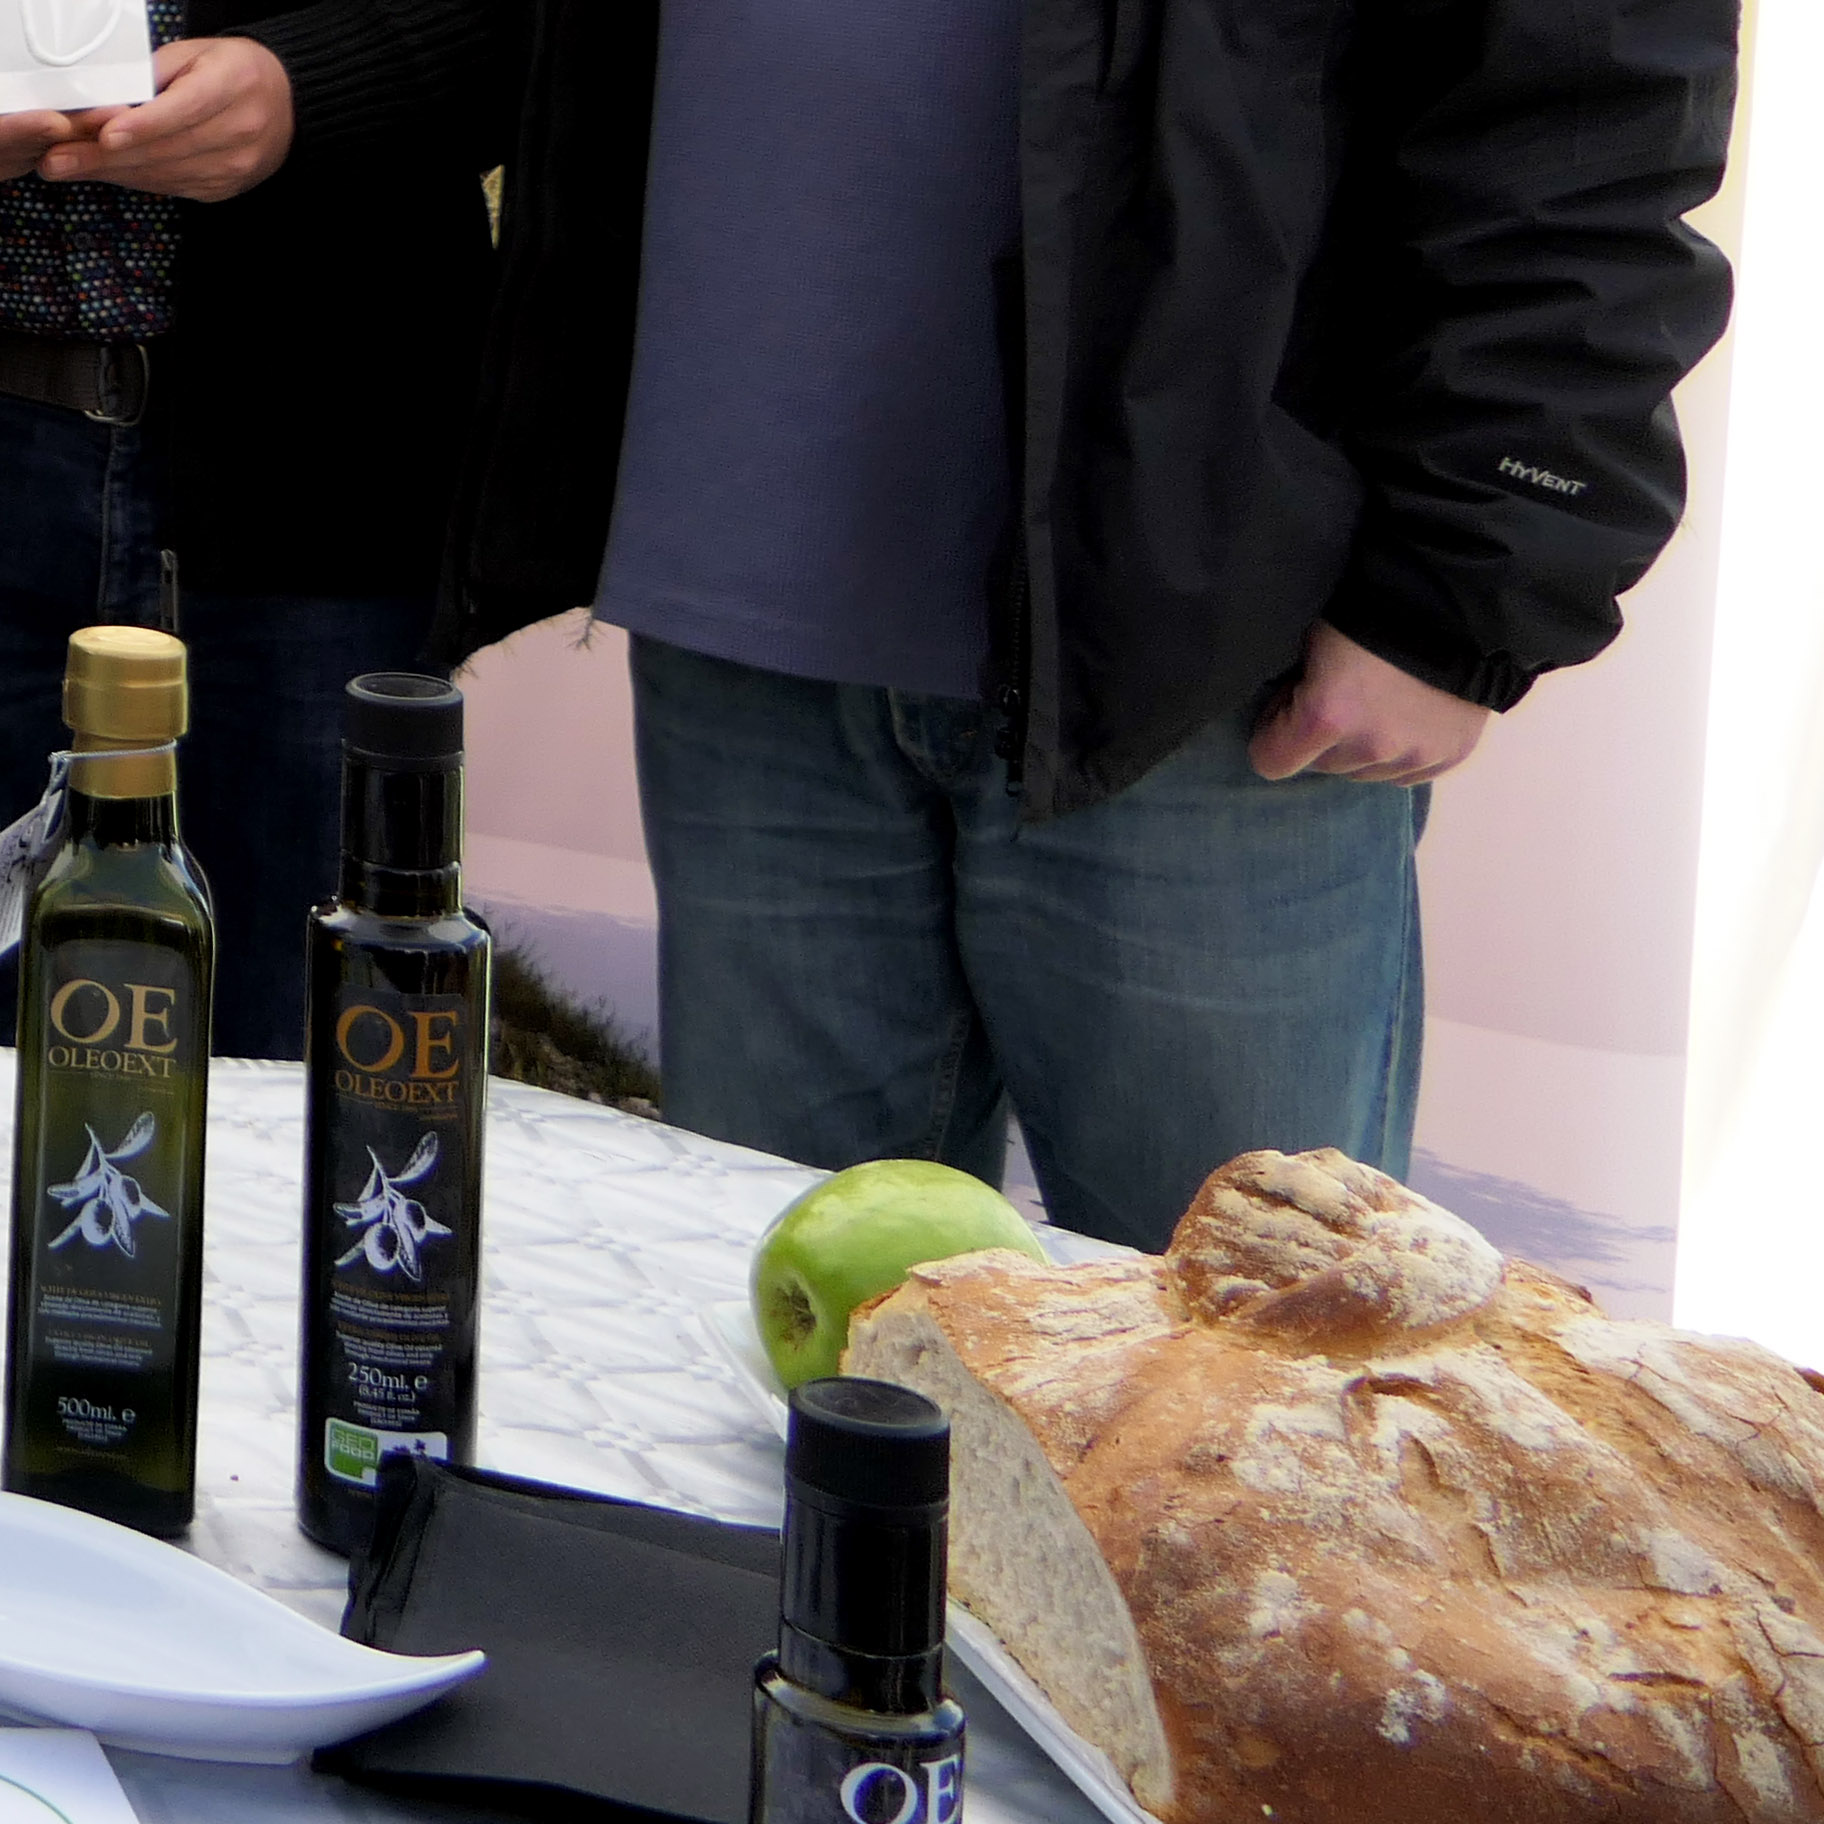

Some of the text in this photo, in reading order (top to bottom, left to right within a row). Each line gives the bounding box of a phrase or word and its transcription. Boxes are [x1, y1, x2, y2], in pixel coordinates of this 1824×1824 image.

[50, 979, 178, 1054] OE
[336, 1005, 460, 1079] OE
[48, 1045, 177, 1078] OLEOEXT
[335, 1070, 460, 1103] OLEOEXT
[840, 1754, 962, 1824] OE
